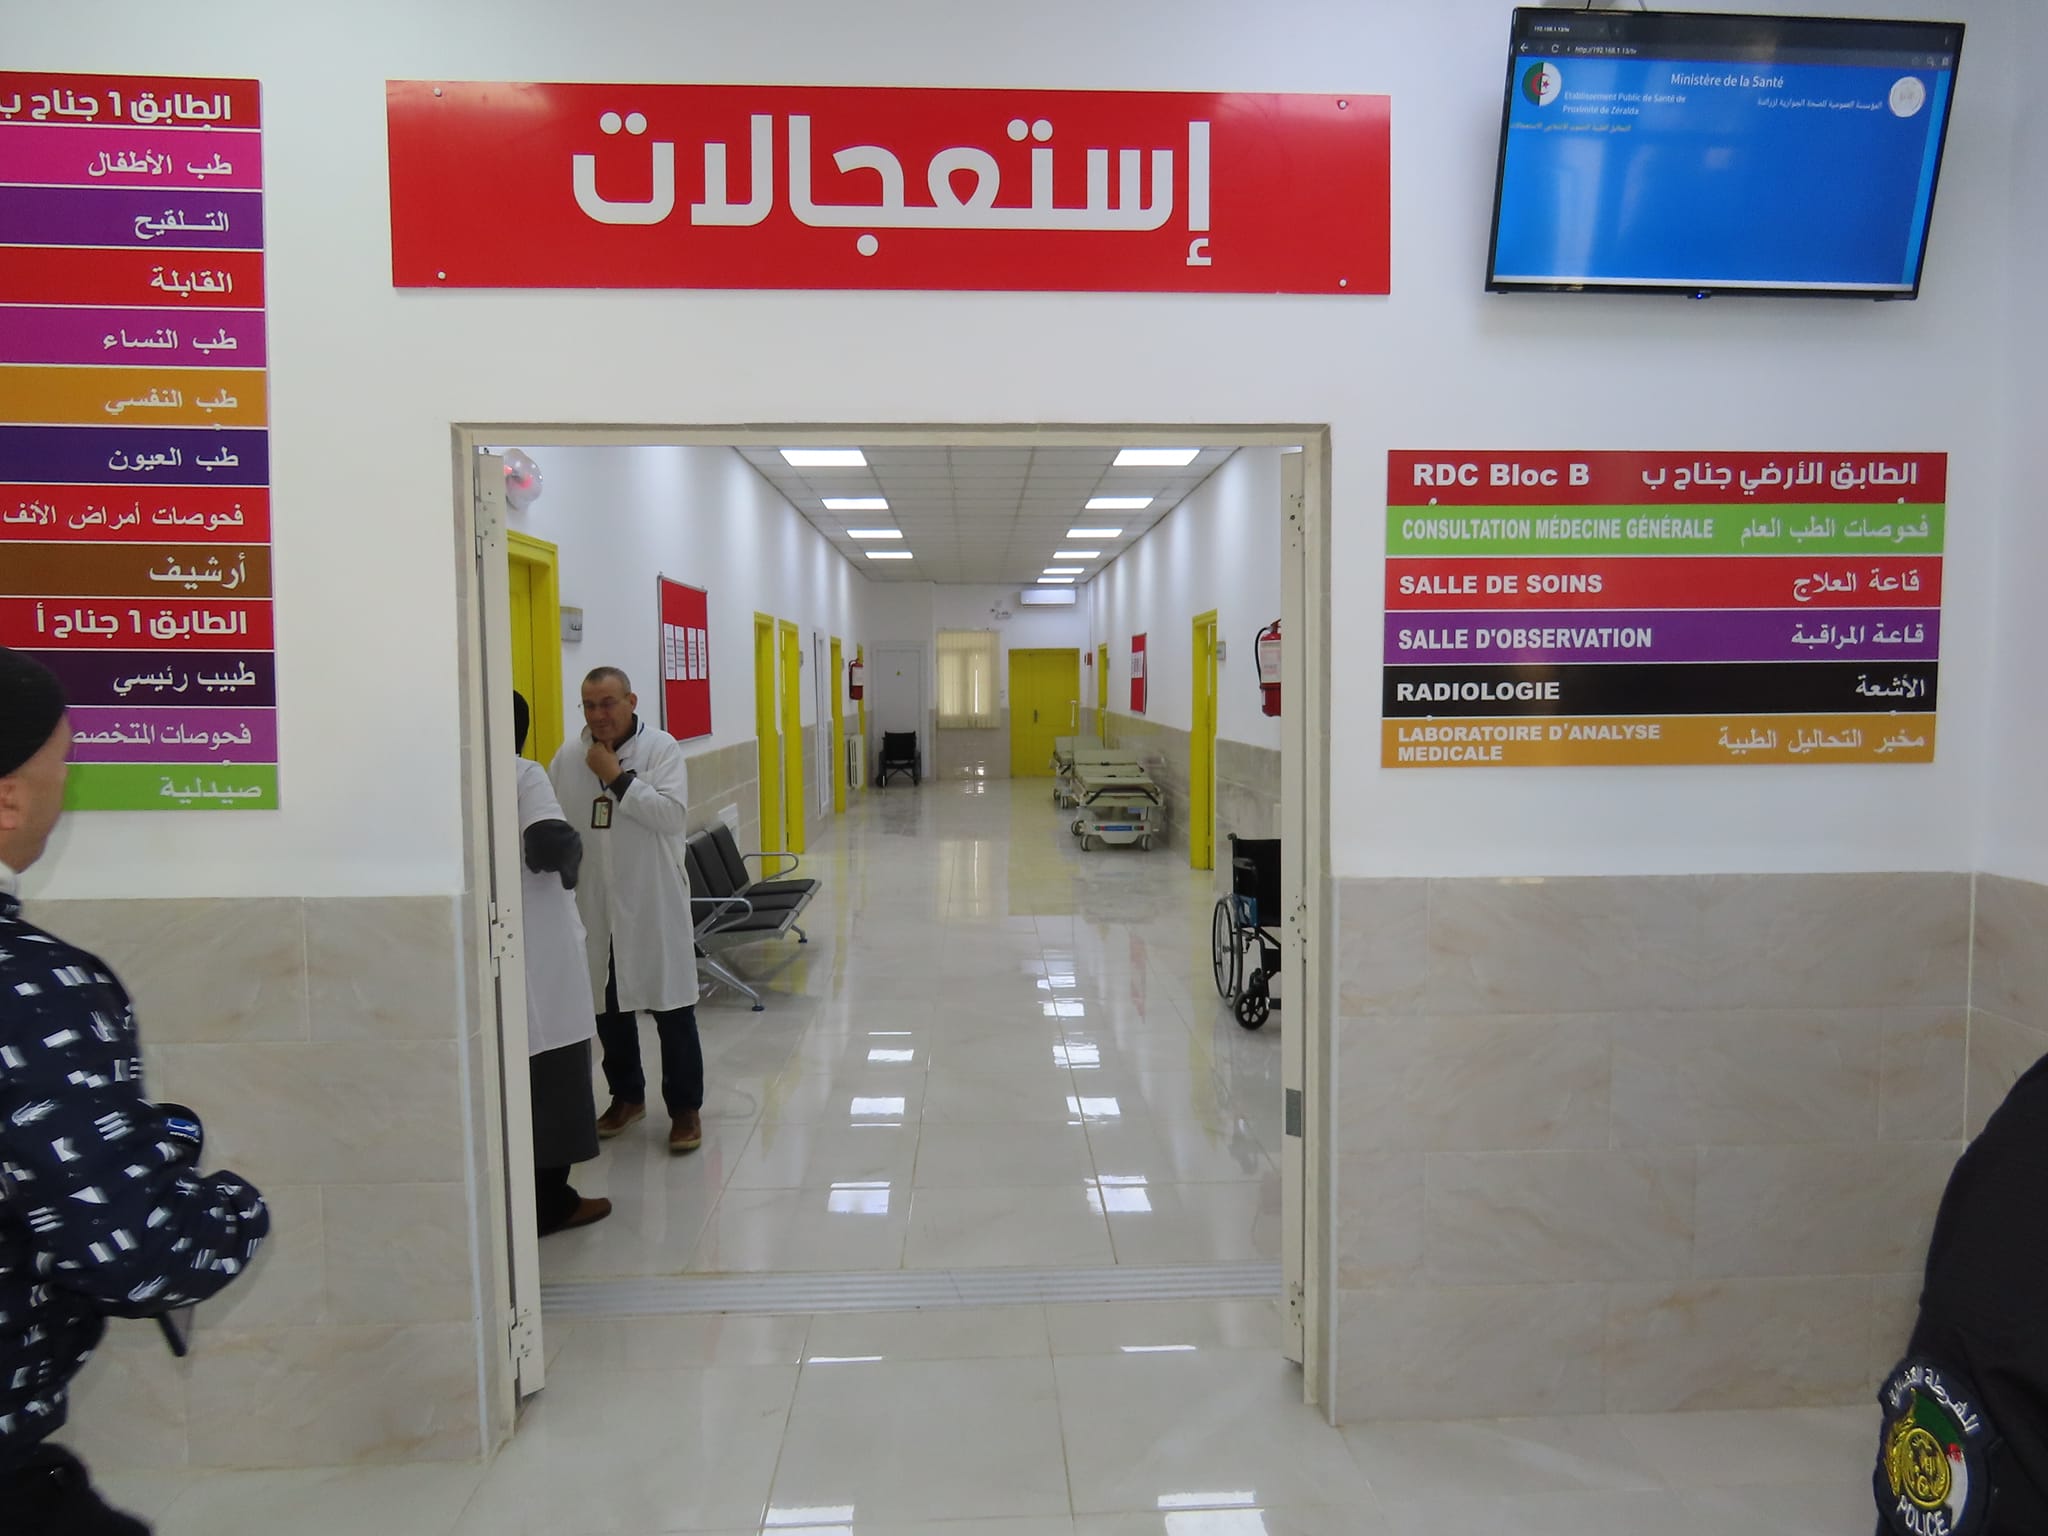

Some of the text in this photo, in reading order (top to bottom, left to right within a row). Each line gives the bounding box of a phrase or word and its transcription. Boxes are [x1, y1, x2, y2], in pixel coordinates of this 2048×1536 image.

[1670, 73, 1785, 89] Ministère de la Santé
[31, 90, 99, 121] جناح
[108, 91, 122, 117] 1
[130, 92, 232, 125] الطابق
[1599, 106, 1610, 115] de
[1618, 93, 1641, 103] Public
[1643, 94, 1653, 103] de
[1654, 94, 1677, 104] Santé
[88, 149, 233, 180] طب الأطفال
[573, 112, 1212, 267] إستعجالات
[150, 266, 233, 299] القابلة
[103, 328, 238, 355] طب النساء
[105, 389, 239, 416] طب النفسي
[108, 447, 239, 471] طب العيون
[1413, 463, 1590, 487] RDC Bloc B
[1641, 460, 1917, 496] الطابق الأرضي جناح ب
[3, 499, 244, 532] فحوصات أمراض الأنف
[1402, 513, 1713, 540] CONSULTATION MÉDECINE GÉNÉRALE
[1740, 514, 1930, 548] فحوصات الطب العام
[149, 552, 247, 591] أرشيف
[1399, 573, 1603, 595] SALLE DE SOINS
[1792, 568, 1921, 602] قاعة العلاج
[36, 602, 247, 640] الطابق 1 جناح أ
[1398, 627, 1652, 650] SALLE D'OBSERVATION
[1791, 622, 1925, 650] قاعة المراقبة
[113, 663, 256, 697] طبيب رئيسي
[1396, 681, 1560, 702] RADIOLOGIE
[1855, 673, 1925, 698] الأشعة
[72, 719, 252, 751] فحوصات المتخصص
[1397, 723, 1661, 743] LABORATOIRE D'ANALYSE
[1718, 726, 1926, 755] مخبر التحاليل الطبية
[1397, 745, 1504, 762] MEDICALE
[159, 776, 262, 805] صيدلية
[1896, 1494, 1950, 1536] POLICE
